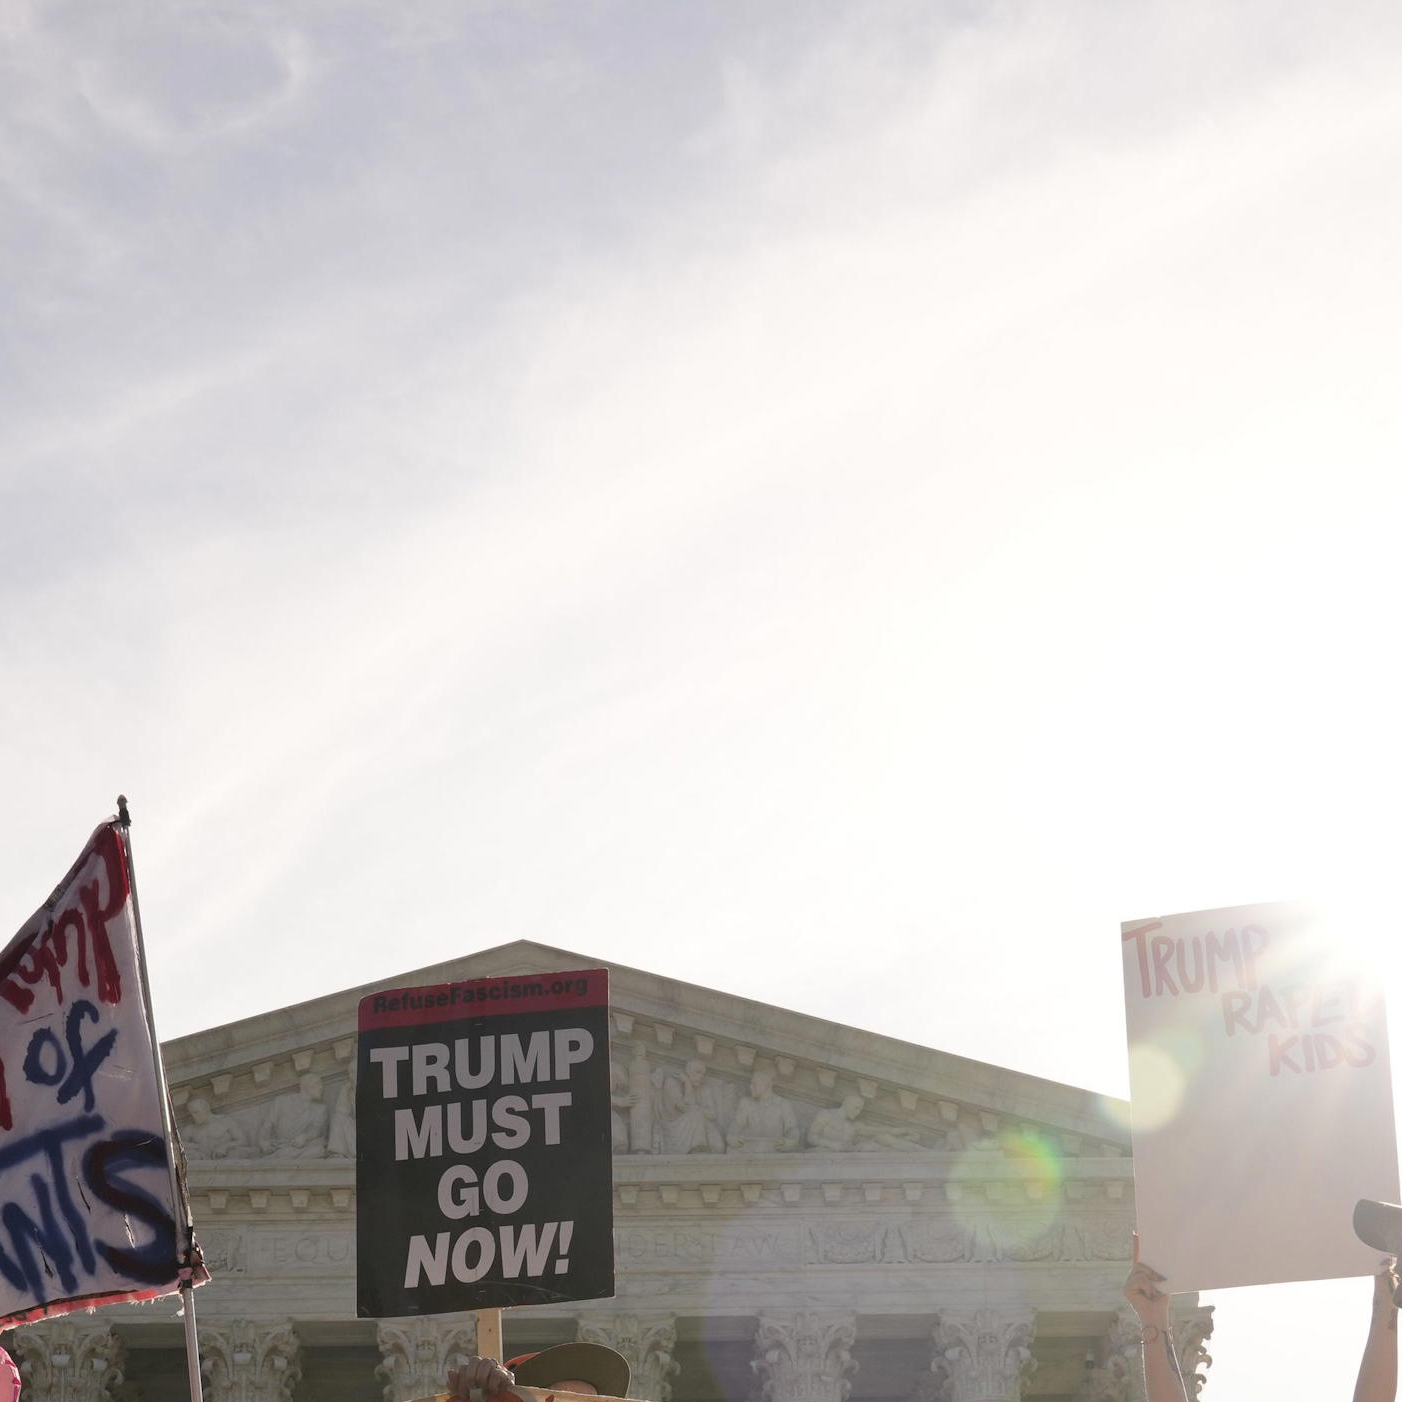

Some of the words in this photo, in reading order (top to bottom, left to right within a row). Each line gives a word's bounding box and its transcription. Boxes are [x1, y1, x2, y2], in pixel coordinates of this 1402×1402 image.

[1122, 921, 1271, 999] TRUMP
[373, 976, 589, 1014] RefuseFascism.org
[1222, 972, 1370, 1036] RAPE
[369, 1027, 595, 1099] TRUMP
[1268, 1022, 1377, 1077] KIDS
[394, 1091, 573, 1161] MUST
[437, 1159, 529, 1220] GO
[403, 1220, 575, 1289] NOW!
